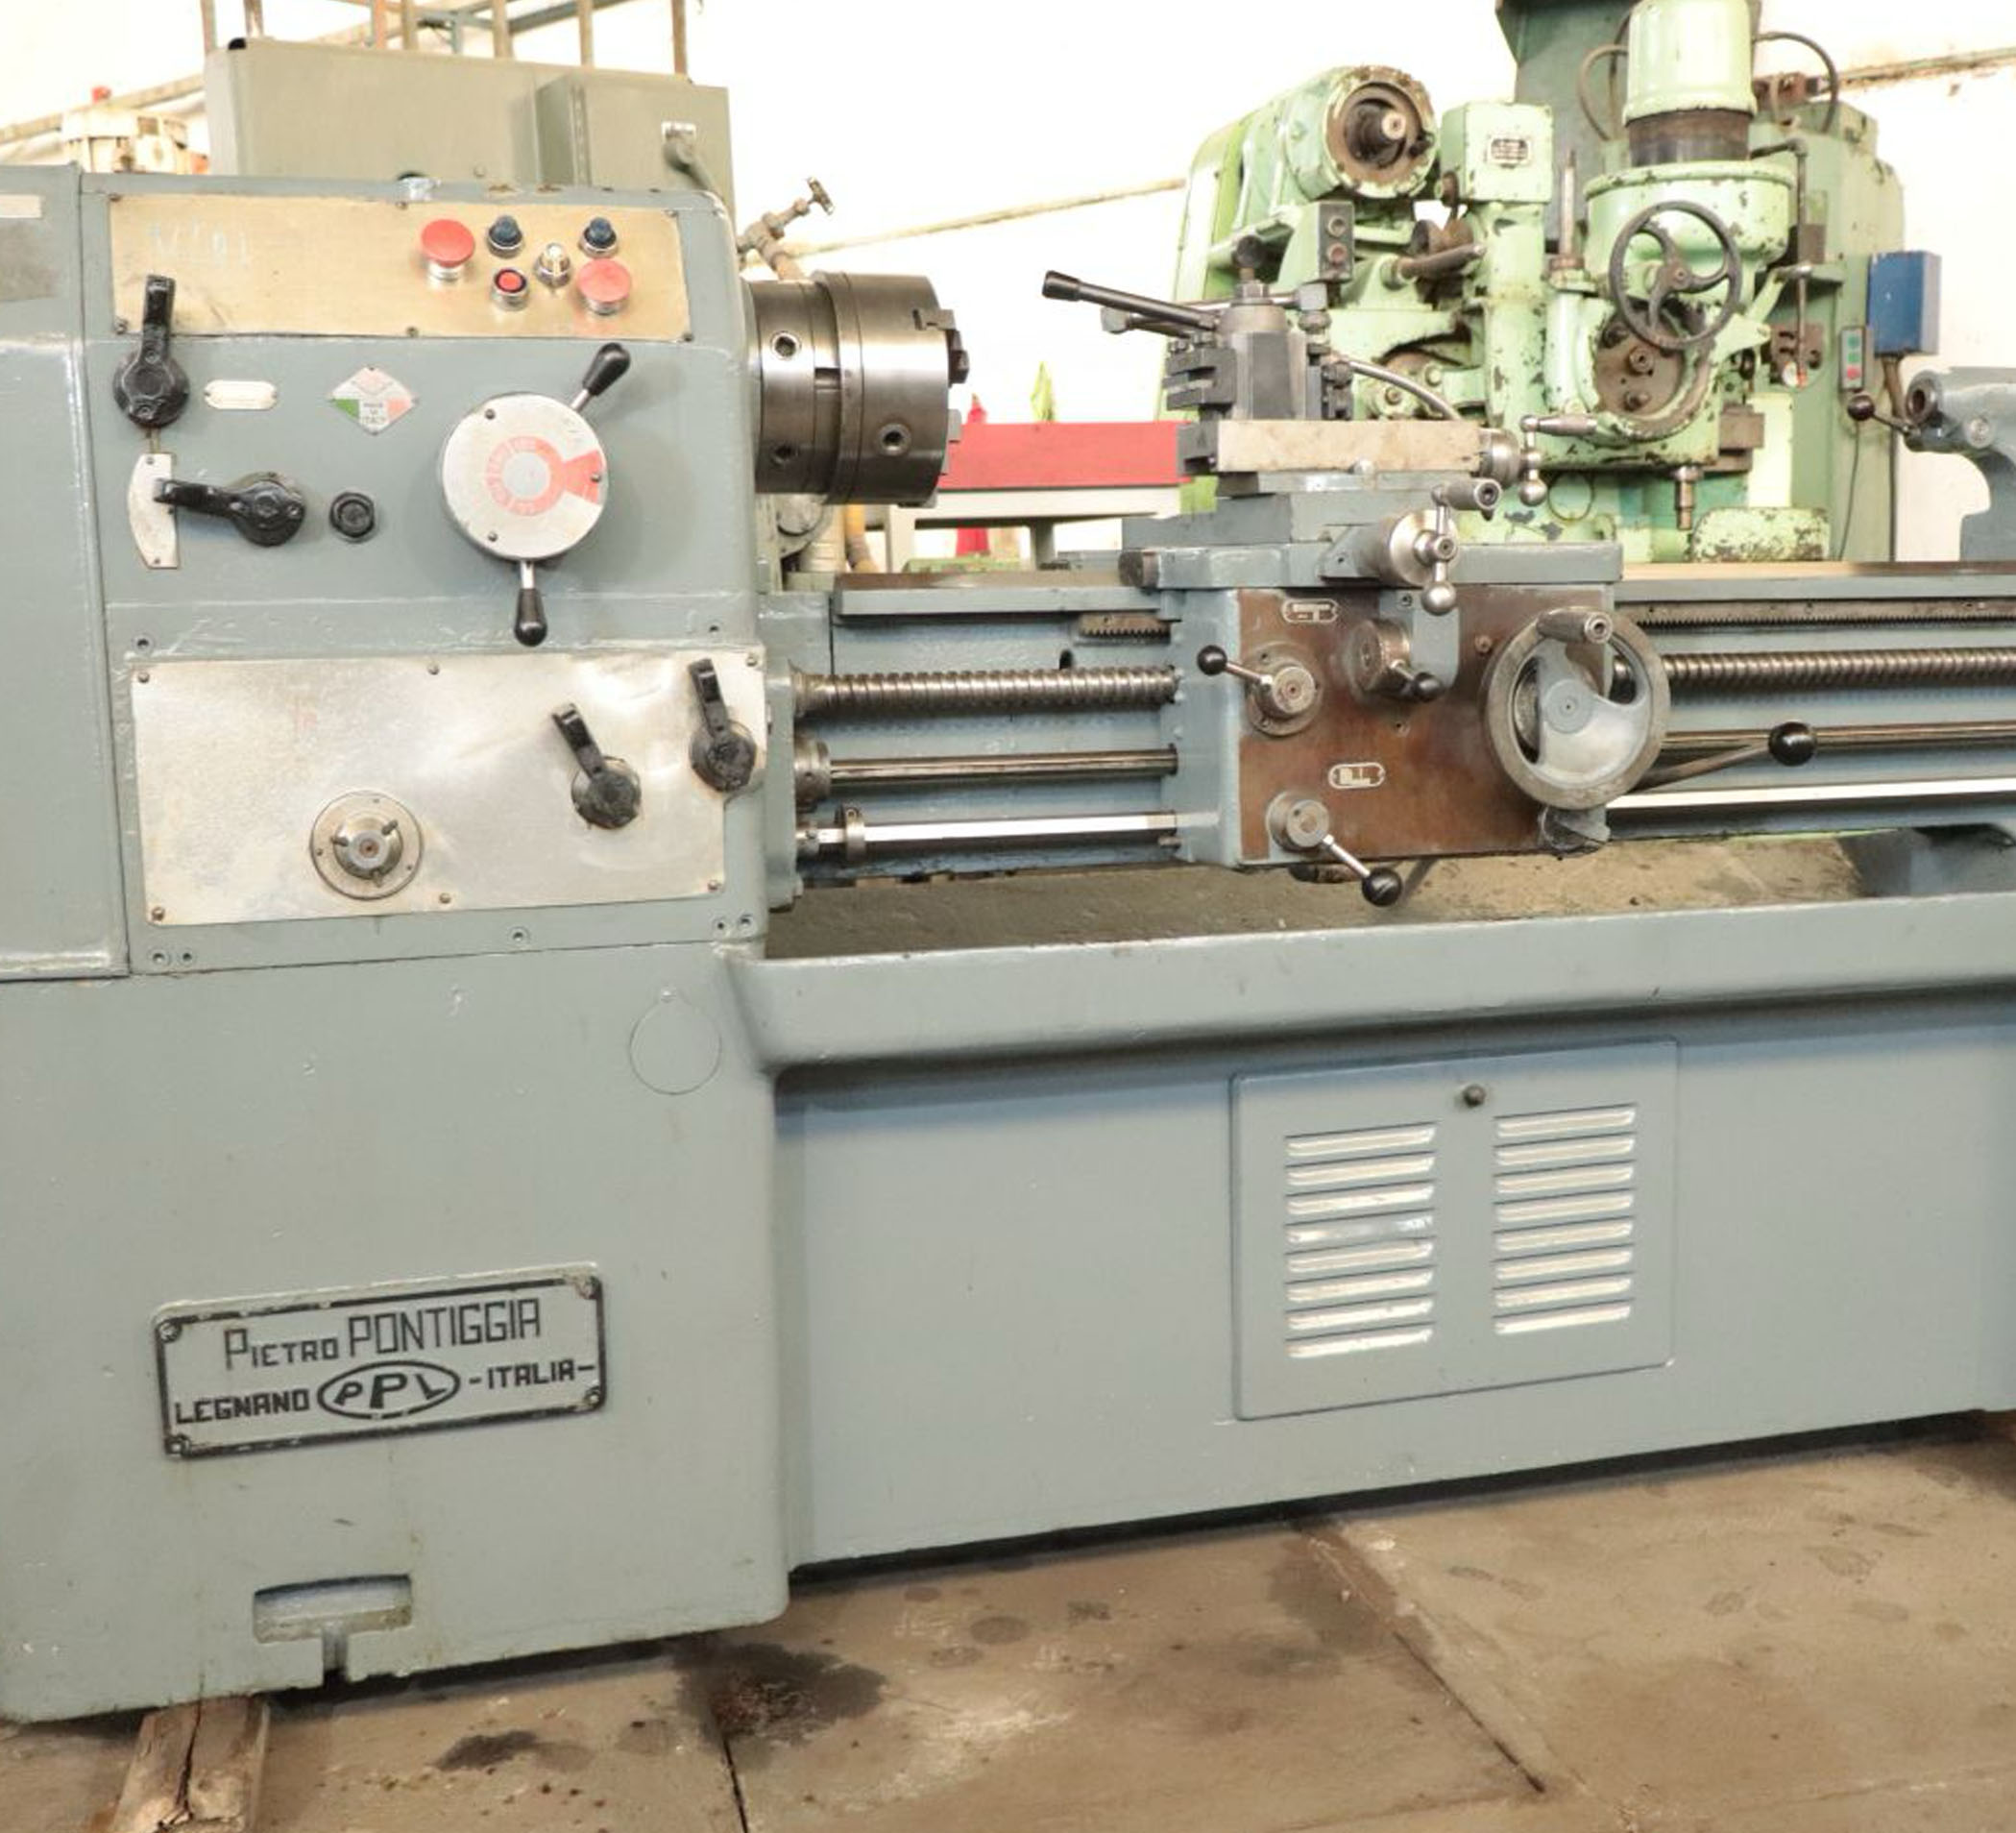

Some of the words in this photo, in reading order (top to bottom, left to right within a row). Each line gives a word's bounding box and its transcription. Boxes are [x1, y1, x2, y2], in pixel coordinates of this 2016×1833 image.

[224, 1328, 339, 1371] PIETRO
[348, 1298, 541, 1357] PONTIGGIA
[175, 1388, 309, 1425] LEGNANO
[333, 1372, 449, 1409] PPL
